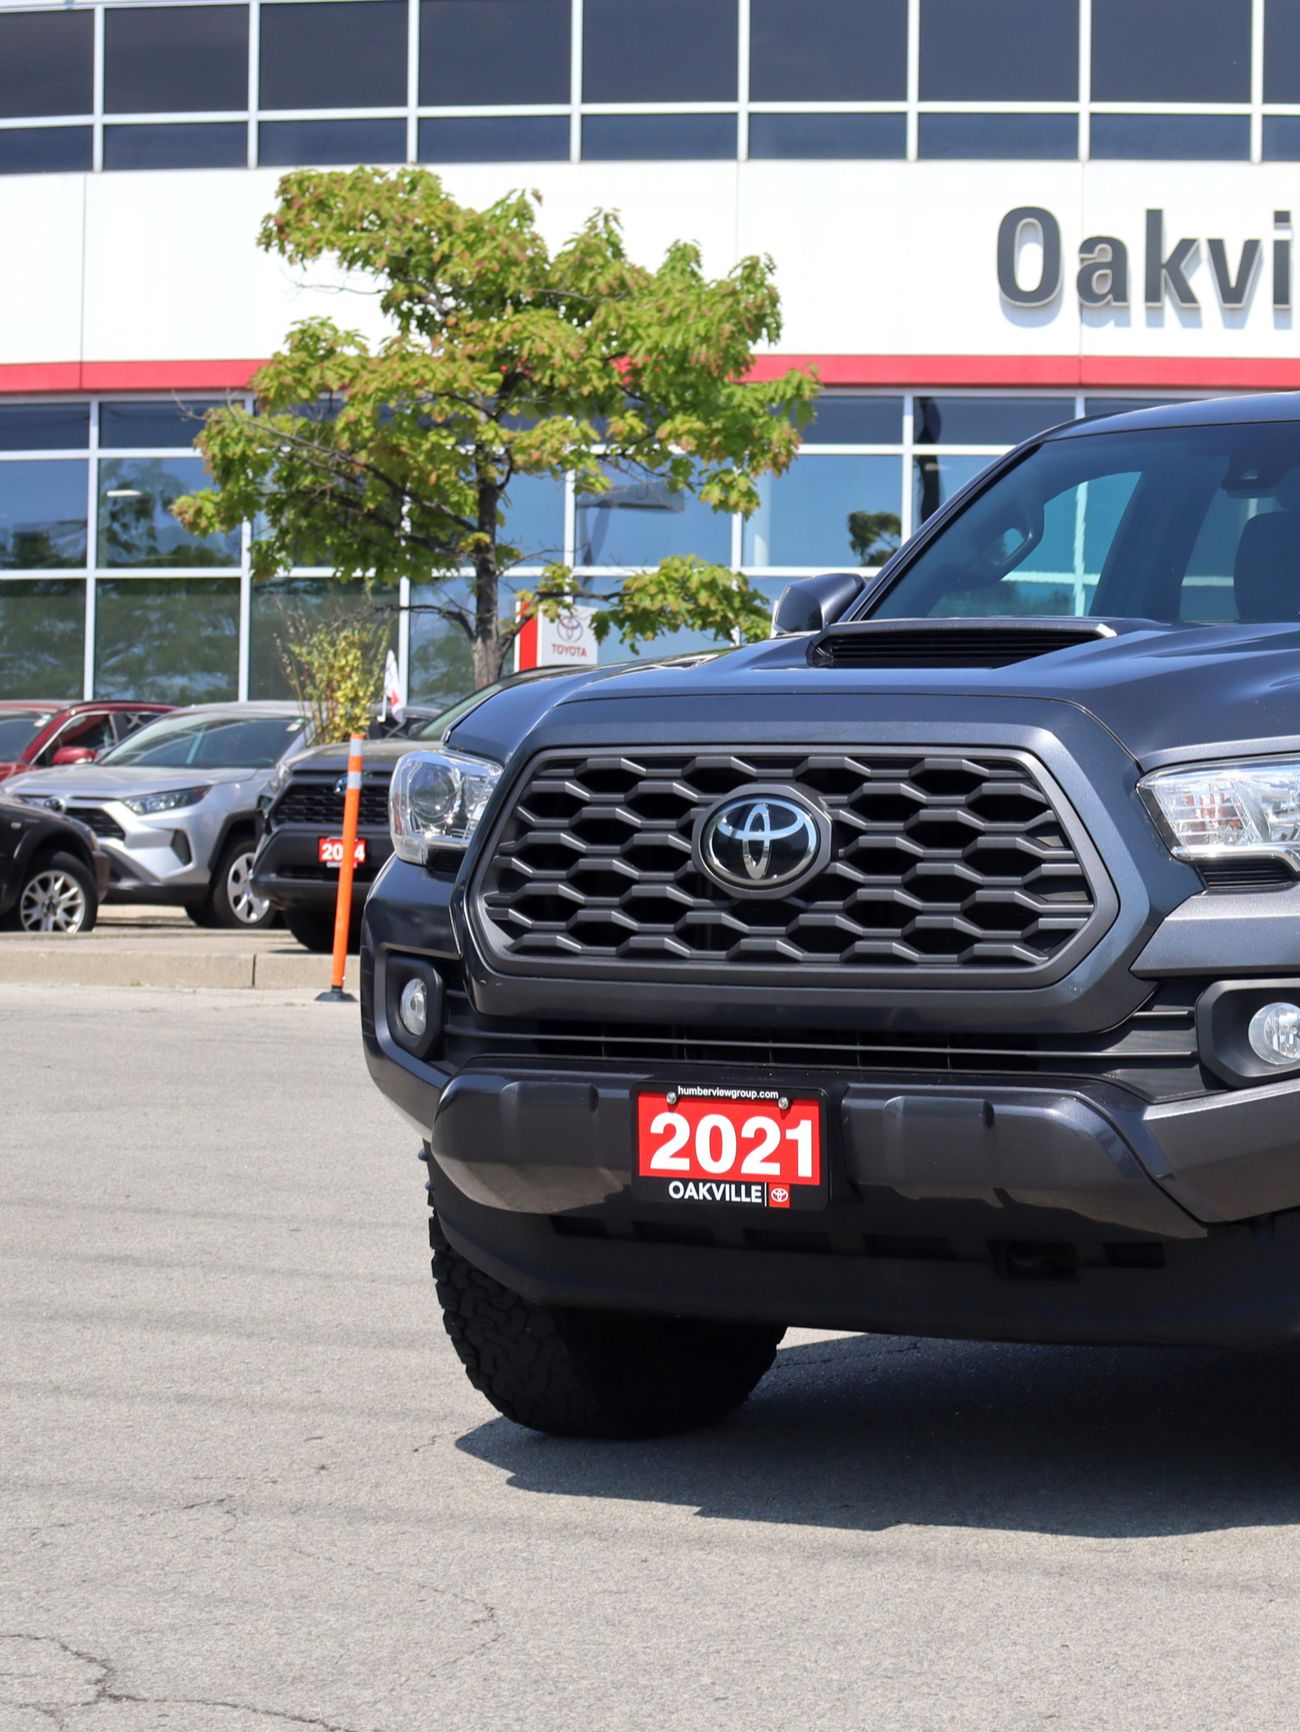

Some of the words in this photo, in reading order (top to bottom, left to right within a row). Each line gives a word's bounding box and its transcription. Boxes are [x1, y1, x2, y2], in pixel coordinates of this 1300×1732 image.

[551, 643, 588, 657] TOYOTA
[321, 843, 366, 862] 204
[677, 1085, 778, 1100] humberviewgroup.com
[650, 1111, 812, 1178] 2021
[668, 1180, 762, 1203] OAKVILLE
